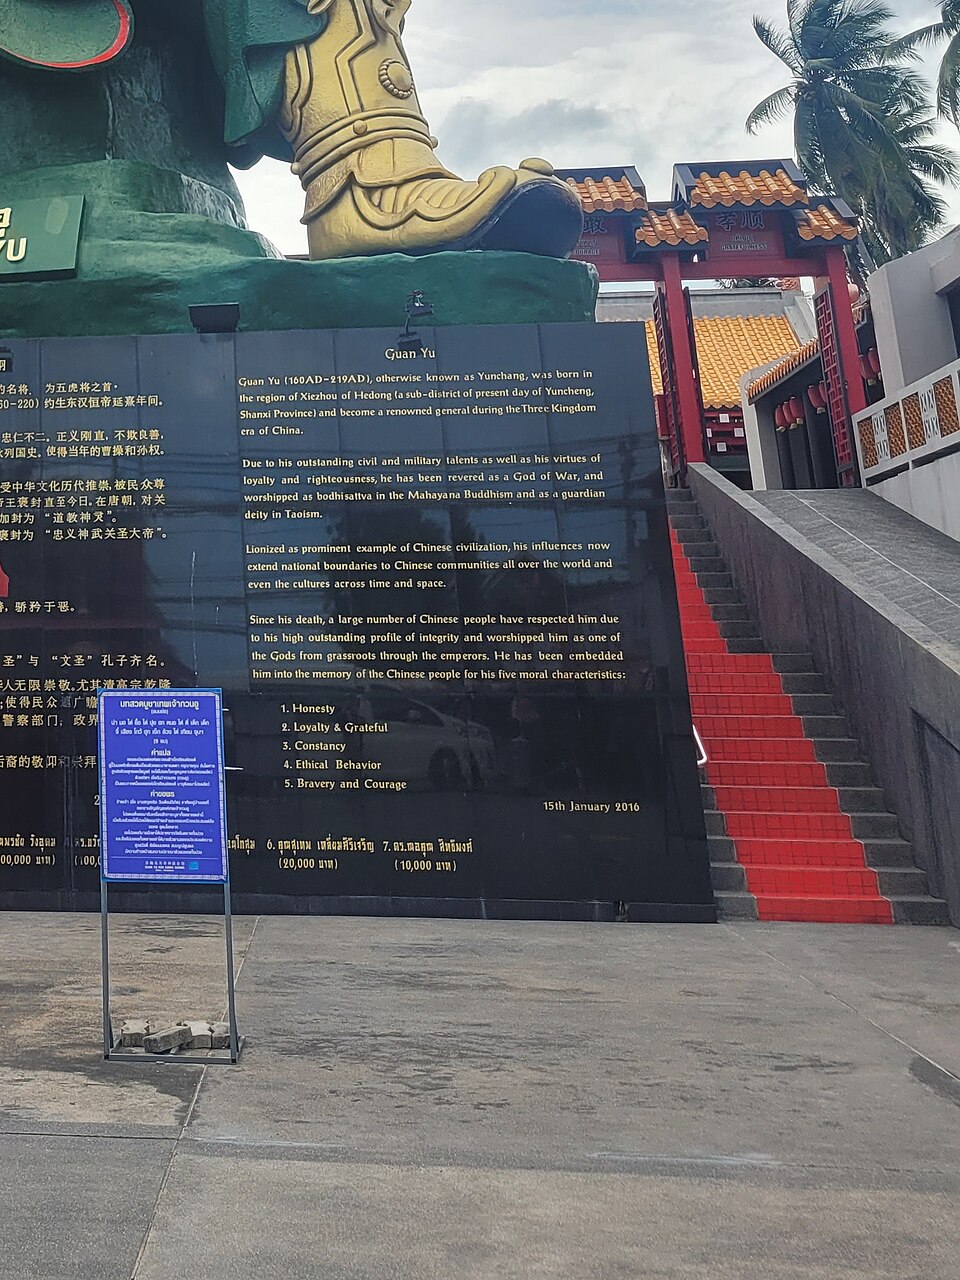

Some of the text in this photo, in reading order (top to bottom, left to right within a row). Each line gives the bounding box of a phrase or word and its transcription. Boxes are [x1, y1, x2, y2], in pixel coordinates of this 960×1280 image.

[384, 347, 436, 361] Guan Yu
[238, 377, 265, 388] Guan
[267, 376, 281, 386] Yu
[375, 373, 423, 383] otherwise
[425, 372, 460, 382] known
[463, 374, 475, 382] as
[555, 369, 580, 379] born
[582, 369, 593, 378] in
[239, 393, 255, 403] the
[254, 393, 286, 404] region
[288, 391, 298, 402] of
[340, 390, 352, 400] of
[353, 390, 393, 402] Hedong
[462, 388, 473, 398] of
[475, 388, 511, 400] present
[511, 387, 532, 398] day
[531, 386, 544, 396] of
[240, 425, 304, 436] era of China.
[242, 453, 601, 469] Due to his outstanding civil and military talents as well as his virtues of
[244, 509, 323, 521] deity in Taoism.
[245, 543, 286, 554] Lionized
[287, 546, 299, 554] as
[300, 544, 352, 555] prominent
[356, 543, 398, 555] example
[399, 542, 411, 553] of
[412, 542, 453, 552] Chinese
[512, 541, 529, 551] his
[531, 540, 583, 551] influences
[587, 543, 611, 551] now
[252, 668, 626, 681] him into the memory of the Chinese people for his five moral characteristics:
[280, 703, 336, 715] 1. Honesty
[281, 721, 389, 734] 2. Loyalty & Grateful
[282, 740, 347, 753] 3. Constancy
[283, 759, 382, 770] 4. Ethical Behavior
[284, 777, 407, 792] 5. Bravery and Courage
[542, 800, 640, 814] 15th January 2016
[266, 838, 276, 850] 6.
[383, 840, 391, 852] 7.
[278, 858, 315, 871] (20,000
[394, 859, 432, 872] (10,000
